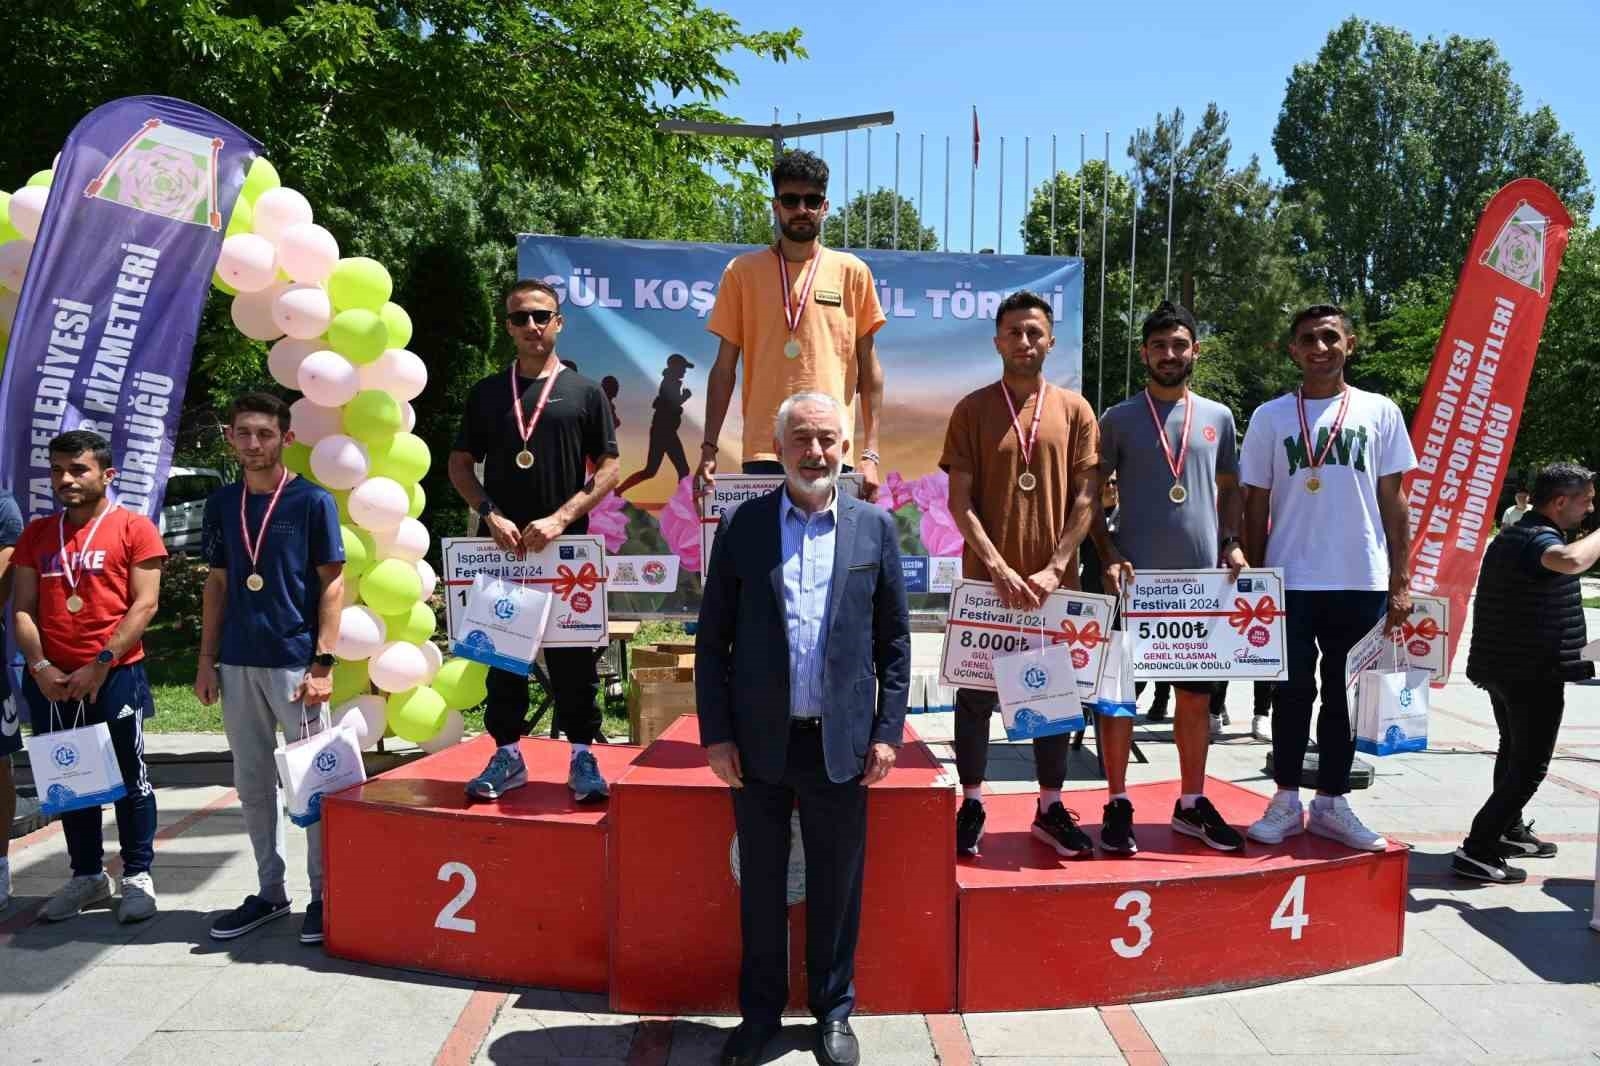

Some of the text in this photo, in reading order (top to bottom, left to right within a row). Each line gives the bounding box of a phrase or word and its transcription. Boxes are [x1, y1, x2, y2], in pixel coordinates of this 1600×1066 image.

[543, 268, 1065, 321] GÜL KOŞ ÜL TÖRİ
[82, 242, 161, 414] HİZMETLERİ
[1459, 296, 1516, 435] HİZMETLERİ
[30, 298, 93, 469] BELEDİYESİ
[1418, 337, 1475, 475] BELEDİYESİ
[113, 371, 175, 515] DÜRLÜĞÜ
[1439, 436, 1475, 503] SPOR
[1456, 400, 1514, 552] MÜDÜRLÜĞÜ
[714, 489, 759, 503] Isparta
[1427, 504, 1453, 534] VE
[455, 566, 543, 578] Festivali 2024
[457, 552, 501, 565] Isparta
[1133, 599, 1220, 611] Festivali 2024
[1135, 583, 1205, 597] Isparta Gül
[959, 608, 1013, 624] Festivali
[1143, 652, 1217, 660] GENEL KLASMAN
[1152, 642, 1171, 650] GÜL
[953, 668, 995, 681] ÜÇÜNCÜL
[1200, 660, 1231, 670] ÖDÜLÜ
[434, 861, 477, 934] 2
[1110, 875, 1310, 959] 3 4
